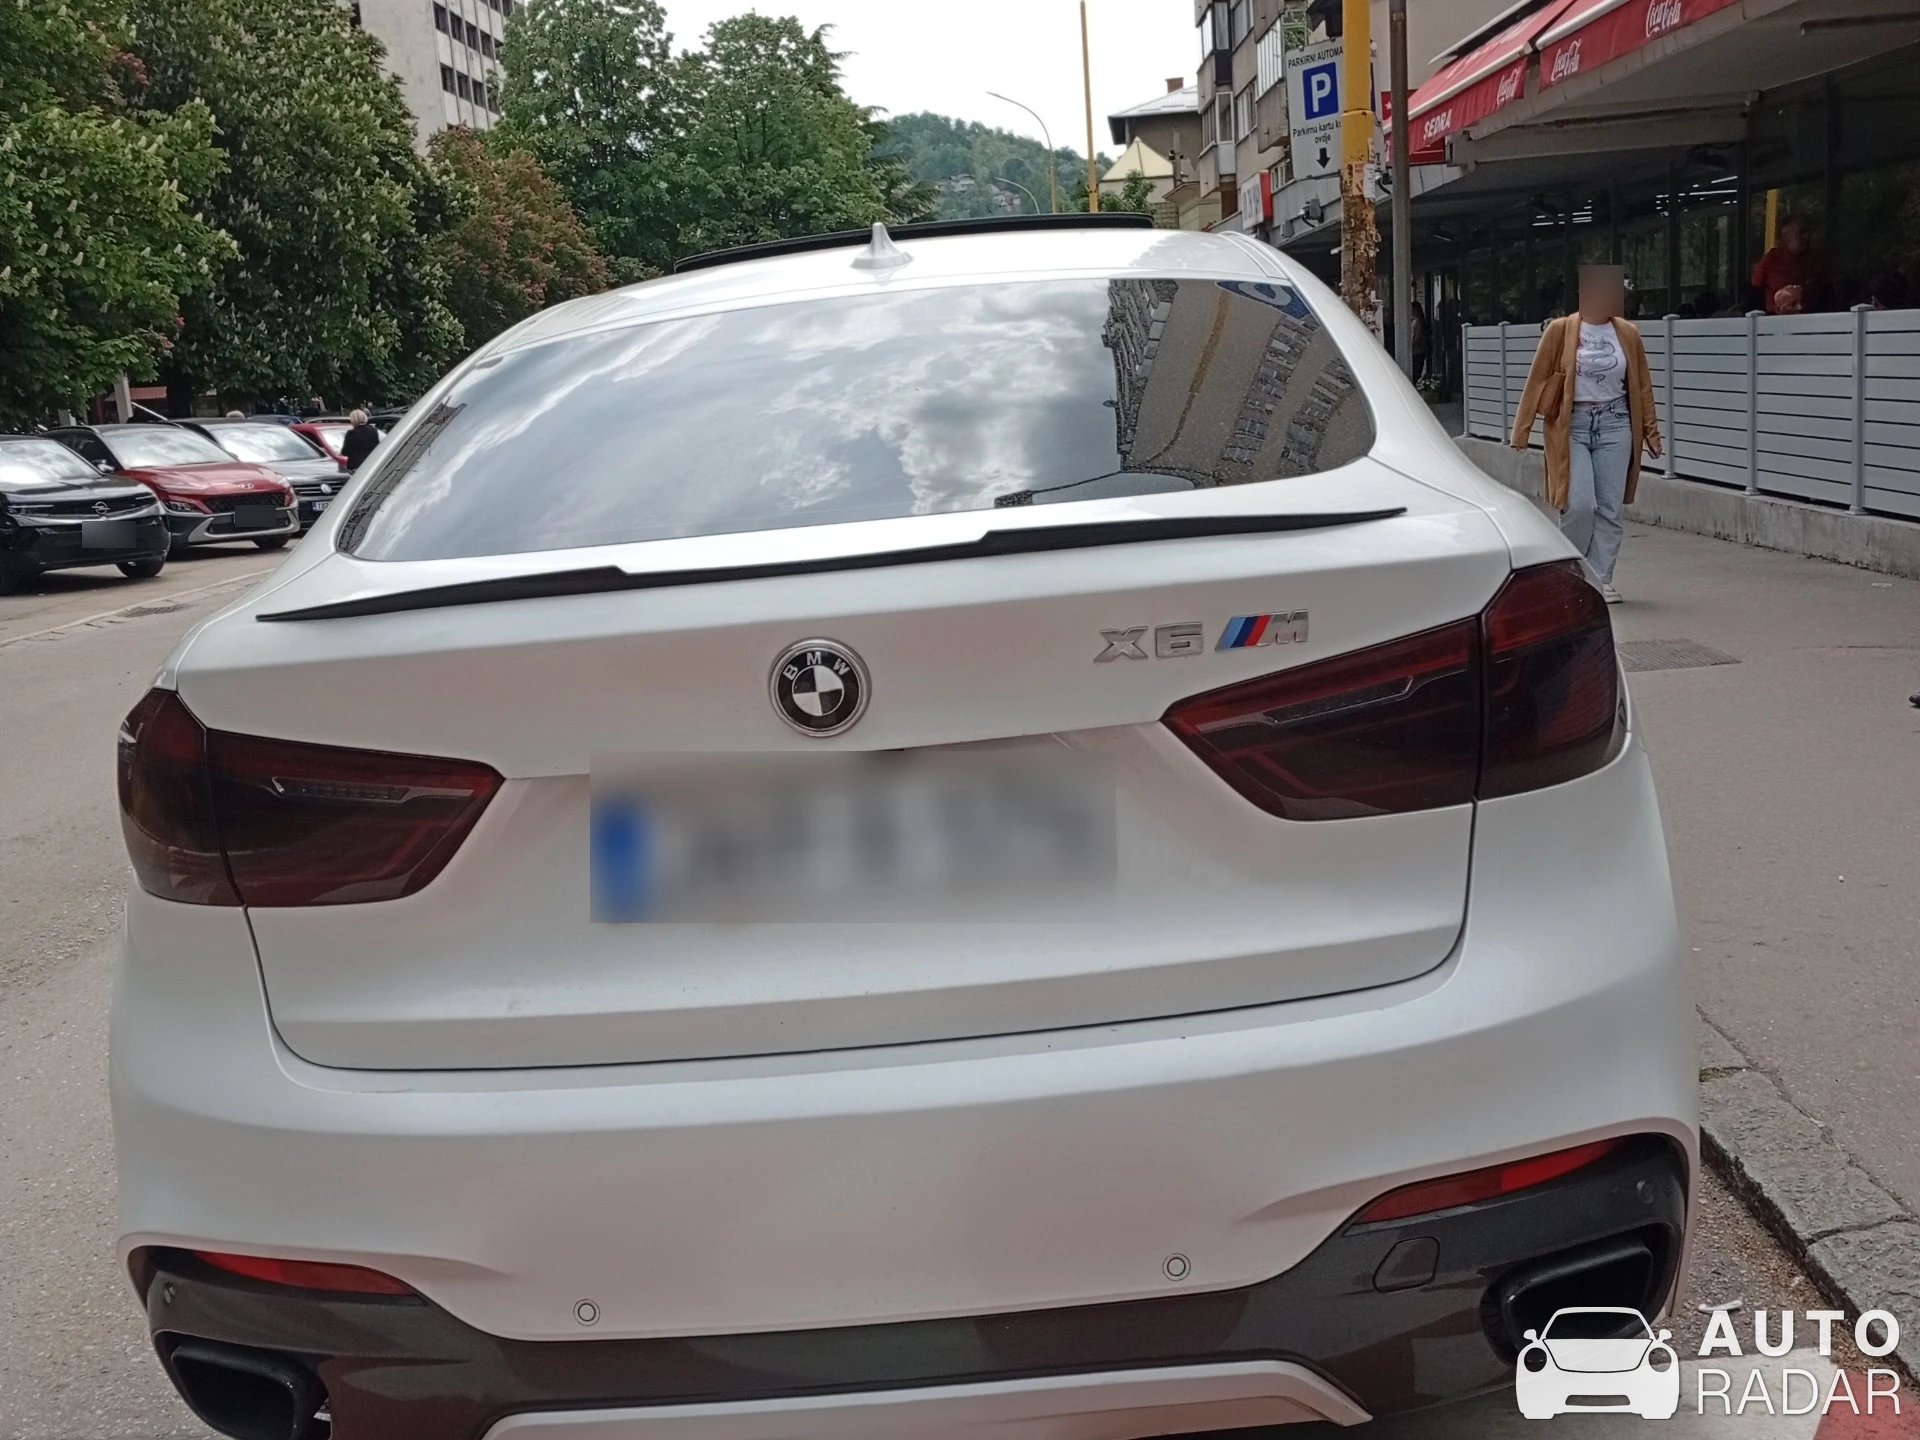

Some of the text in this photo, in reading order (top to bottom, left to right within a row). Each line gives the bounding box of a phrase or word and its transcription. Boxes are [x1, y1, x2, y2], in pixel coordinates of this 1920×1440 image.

[1288, 46, 1344, 68] PARKIRNI AUTOMA
[1311, 72, 1331, 113] P
[1293, 126, 1318, 138] Parkirnu
[1319, 122, 1335, 132] kartu
[1315, 133, 1331, 144] ovdje
[1423, 109, 1452, 140] SEDRA
[1093, 621, 1204, 662] X6
[782, 651, 851, 681] BMW
